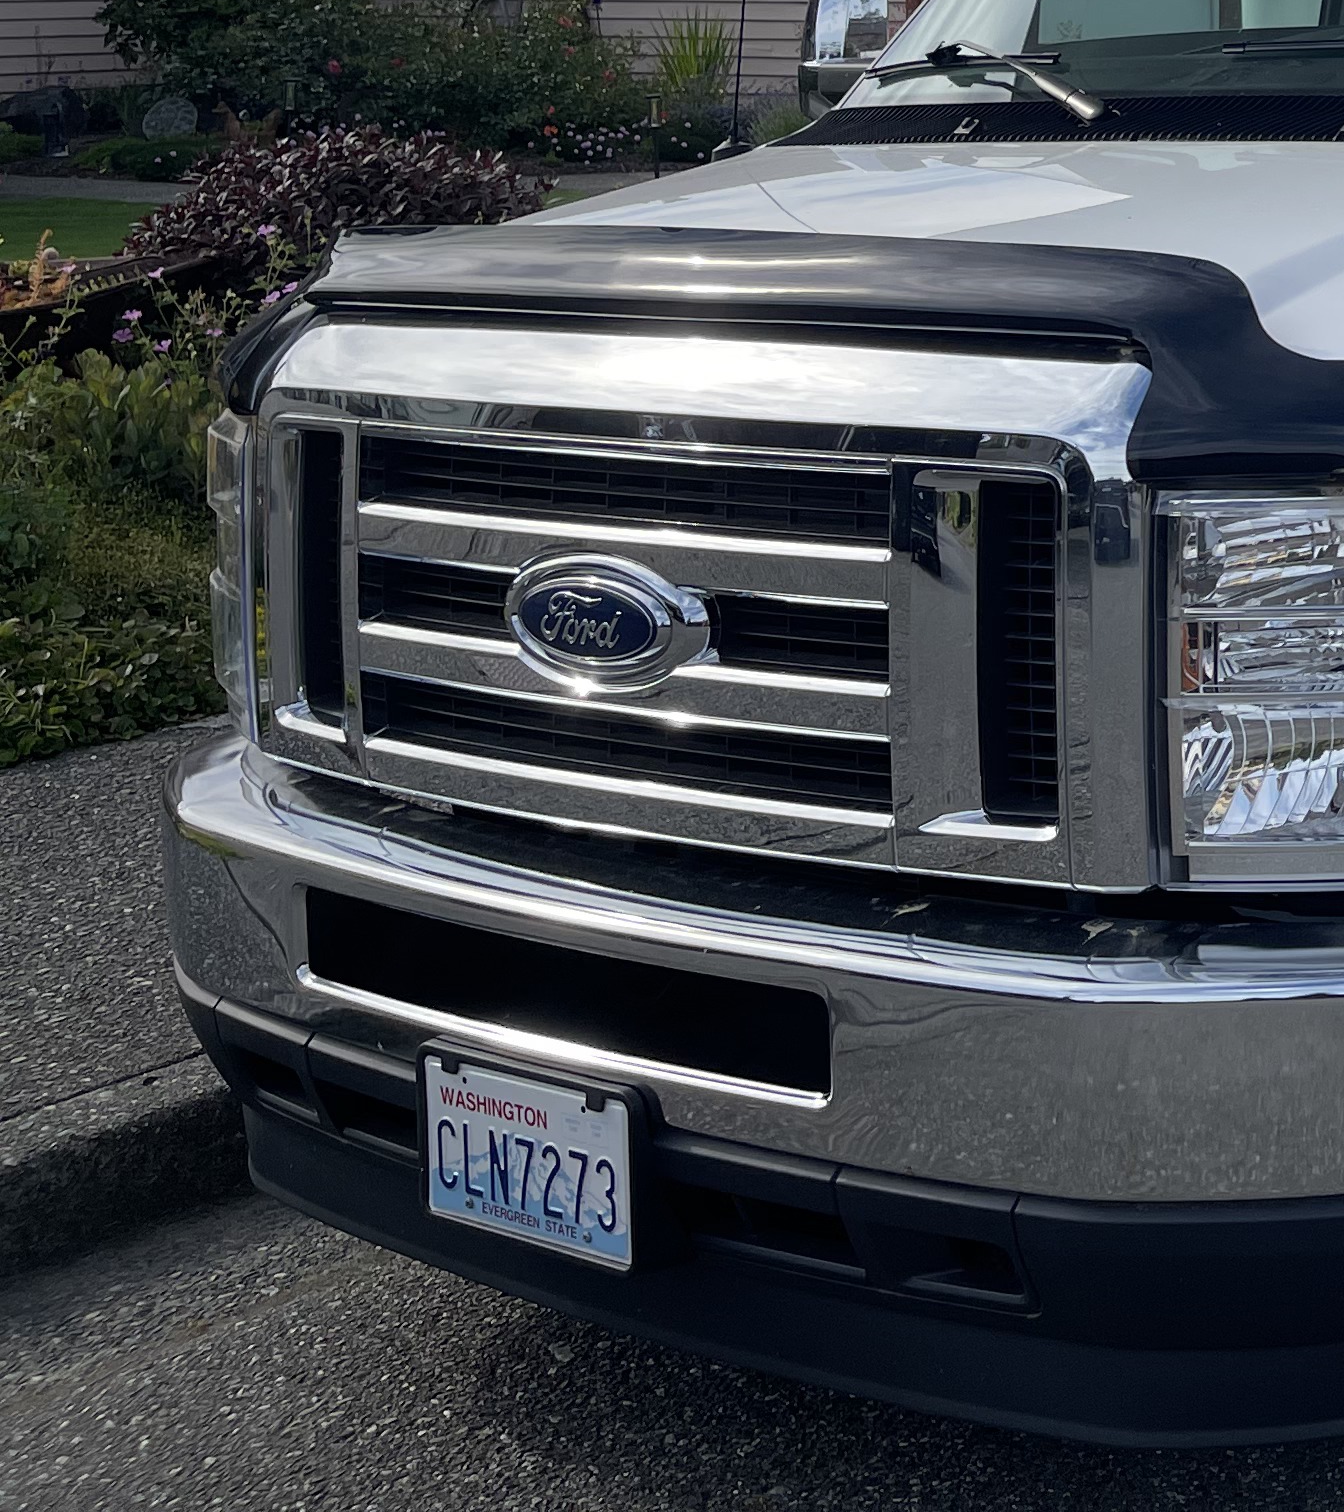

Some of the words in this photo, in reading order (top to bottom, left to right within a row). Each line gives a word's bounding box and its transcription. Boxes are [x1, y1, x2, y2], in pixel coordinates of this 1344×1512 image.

[540, 590, 622, 649] Ford
[440, 1085, 548, 1130] WASHINGTON
[437, 1118, 617, 1233] CLN7273
[482, 1201, 541, 1229] EVERGREEN
[545, 1219, 578, 1240] STATE
